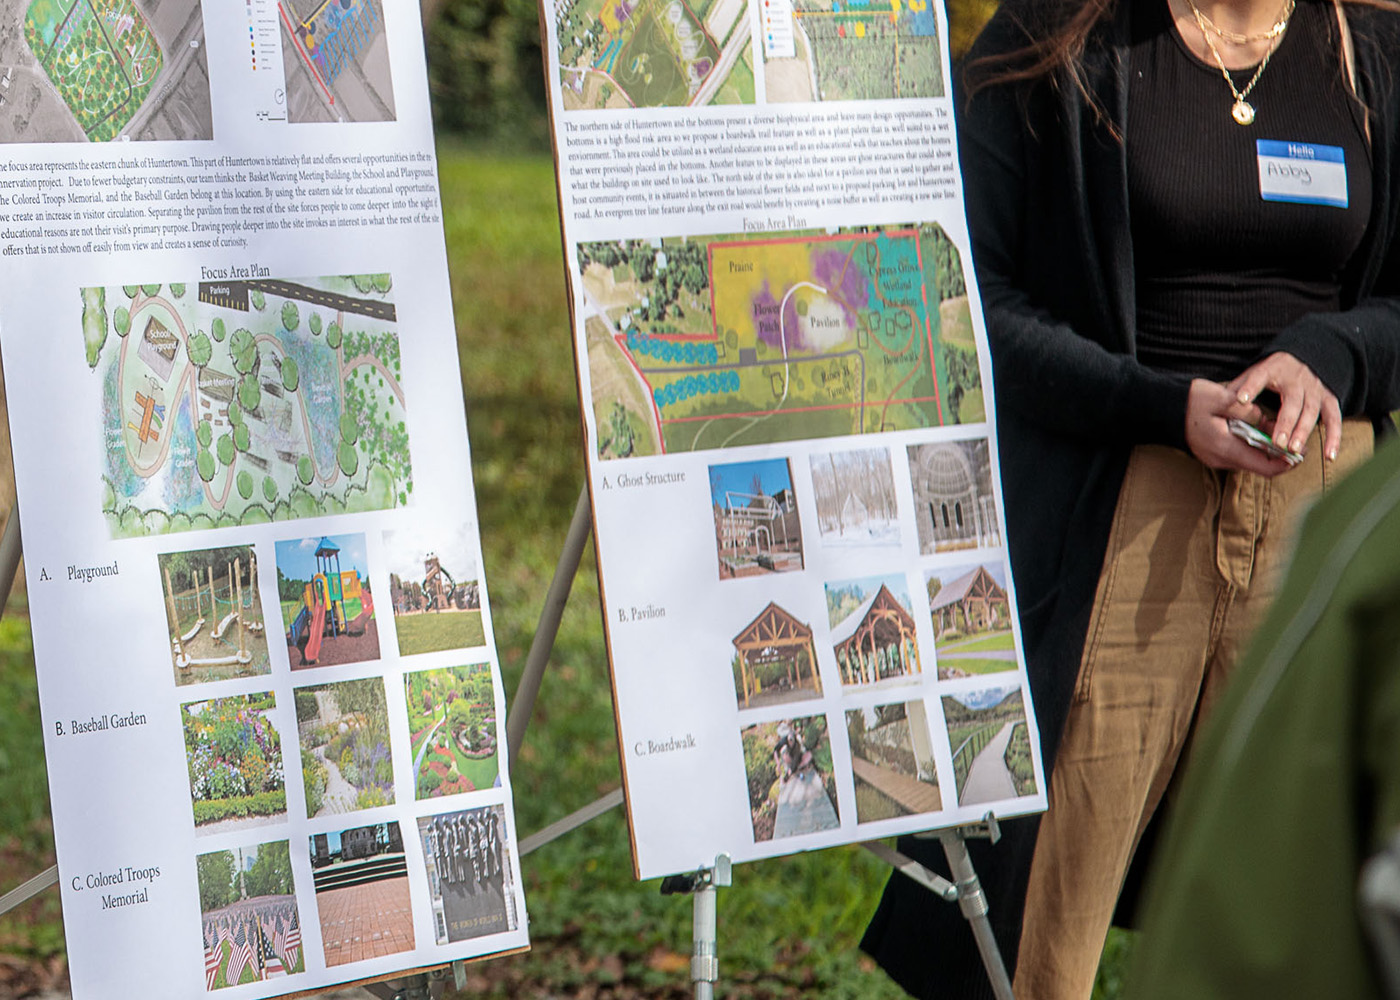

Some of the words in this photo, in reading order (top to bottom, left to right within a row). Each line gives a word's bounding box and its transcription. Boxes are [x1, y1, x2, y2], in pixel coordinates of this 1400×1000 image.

[1267, 161, 1312, 185] Abby
[743, 219, 765, 232] Focus
[767, 217, 785, 230] Area
[787, 215, 807, 228] Plan
[200, 266, 227, 279] Focus
[229, 265, 249, 278] Area
[250, 263, 270, 277] Plan
[209, 285, 230, 297] Parking
[754, 304, 780, 316] Flower
[759, 321, 780, 333] Patch
[810, 317, 841, 329] Pavilion
[602, 476, 612, 489] A.
[616, 473, 643, 487] Ghost
[644, 471, 685, 485] Structure
[39, 567, 51, 581] A.
[67, 560, 118, 583] Playground
[618, 608, 628, 622] B.
[630, 604, 665, 621] Pavilion
[55, 721, 65, 735] B.
[71, 714, 108, 734] Baseball
[110, 711, 146, 728] Garden
[634, 742, 645, 756] C.
[647, 734, 695, 754] Boardwalk
[71, 876, 83, 891] C.
[85, 868, 123, 888] Colored
[124, 866, 160, 882] Troops
[101, 887, 148, 909] Memorial
